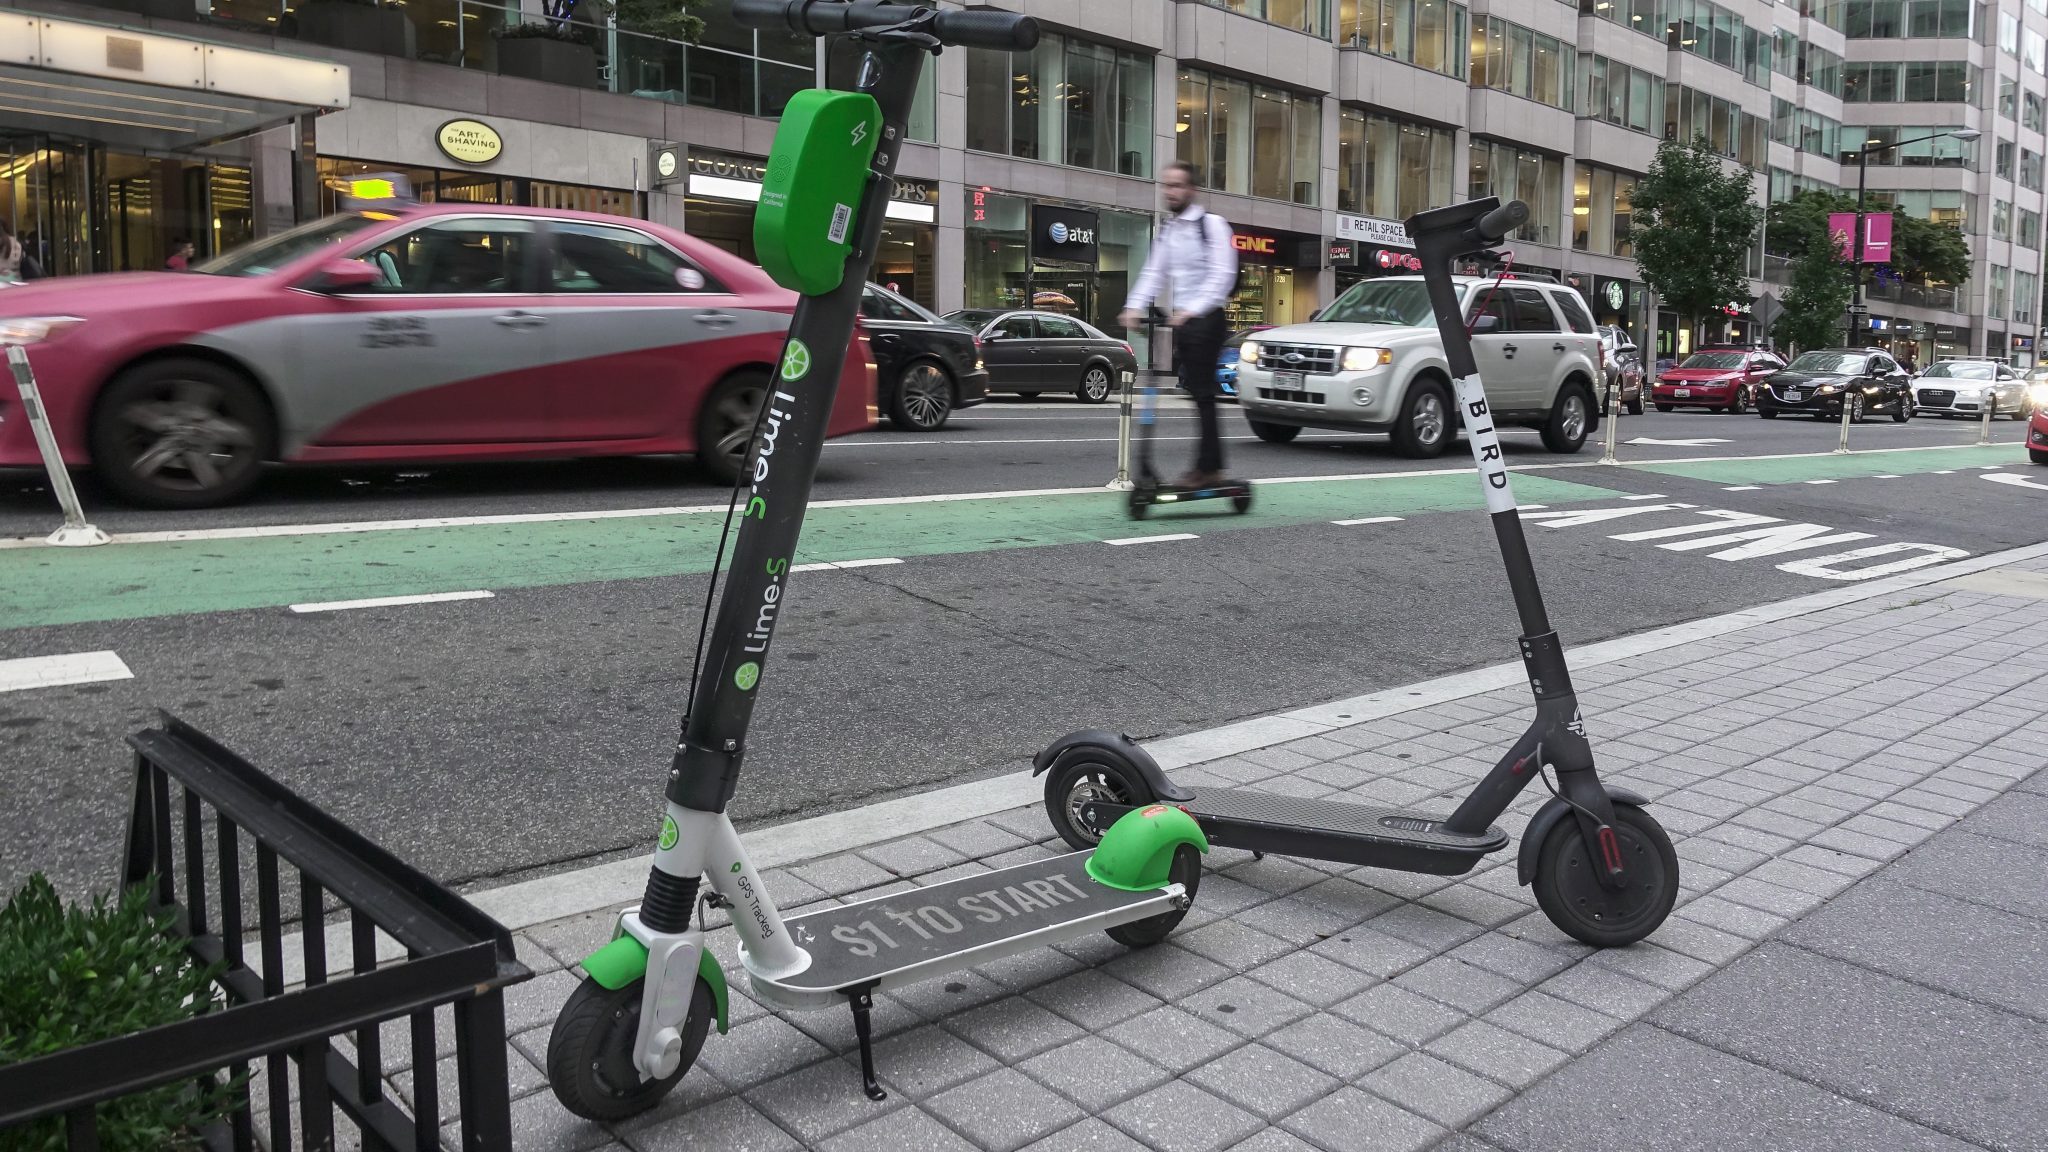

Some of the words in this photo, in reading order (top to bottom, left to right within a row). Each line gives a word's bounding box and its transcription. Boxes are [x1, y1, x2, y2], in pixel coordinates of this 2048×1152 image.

[447, 136, 495, 148] SHAVING
[459, 130, 480, 139] ART
[890, 182, 926, 201] OPS
[1069, 227, 1094, 245] at&t
[1354, 219, 1379, 233] RETAIL
[1381, 223, 1403, 237] SPACE
[1867, 218, 1888, 245] L
[1231, 234, 1275, 253] GNC
[1370, 233, 1387, 241] PLEASE
[1387, 235, 1397, 243] CALL
[1468, 397, 1508, 490] BIRD
[737, 875, 754, 899] GPS
[749, 896, 776, 939] Tracked
[831, 920, 900, 958] $1
[893, 904, 964, 940] TO
[956, 873, 1090, 924] START
